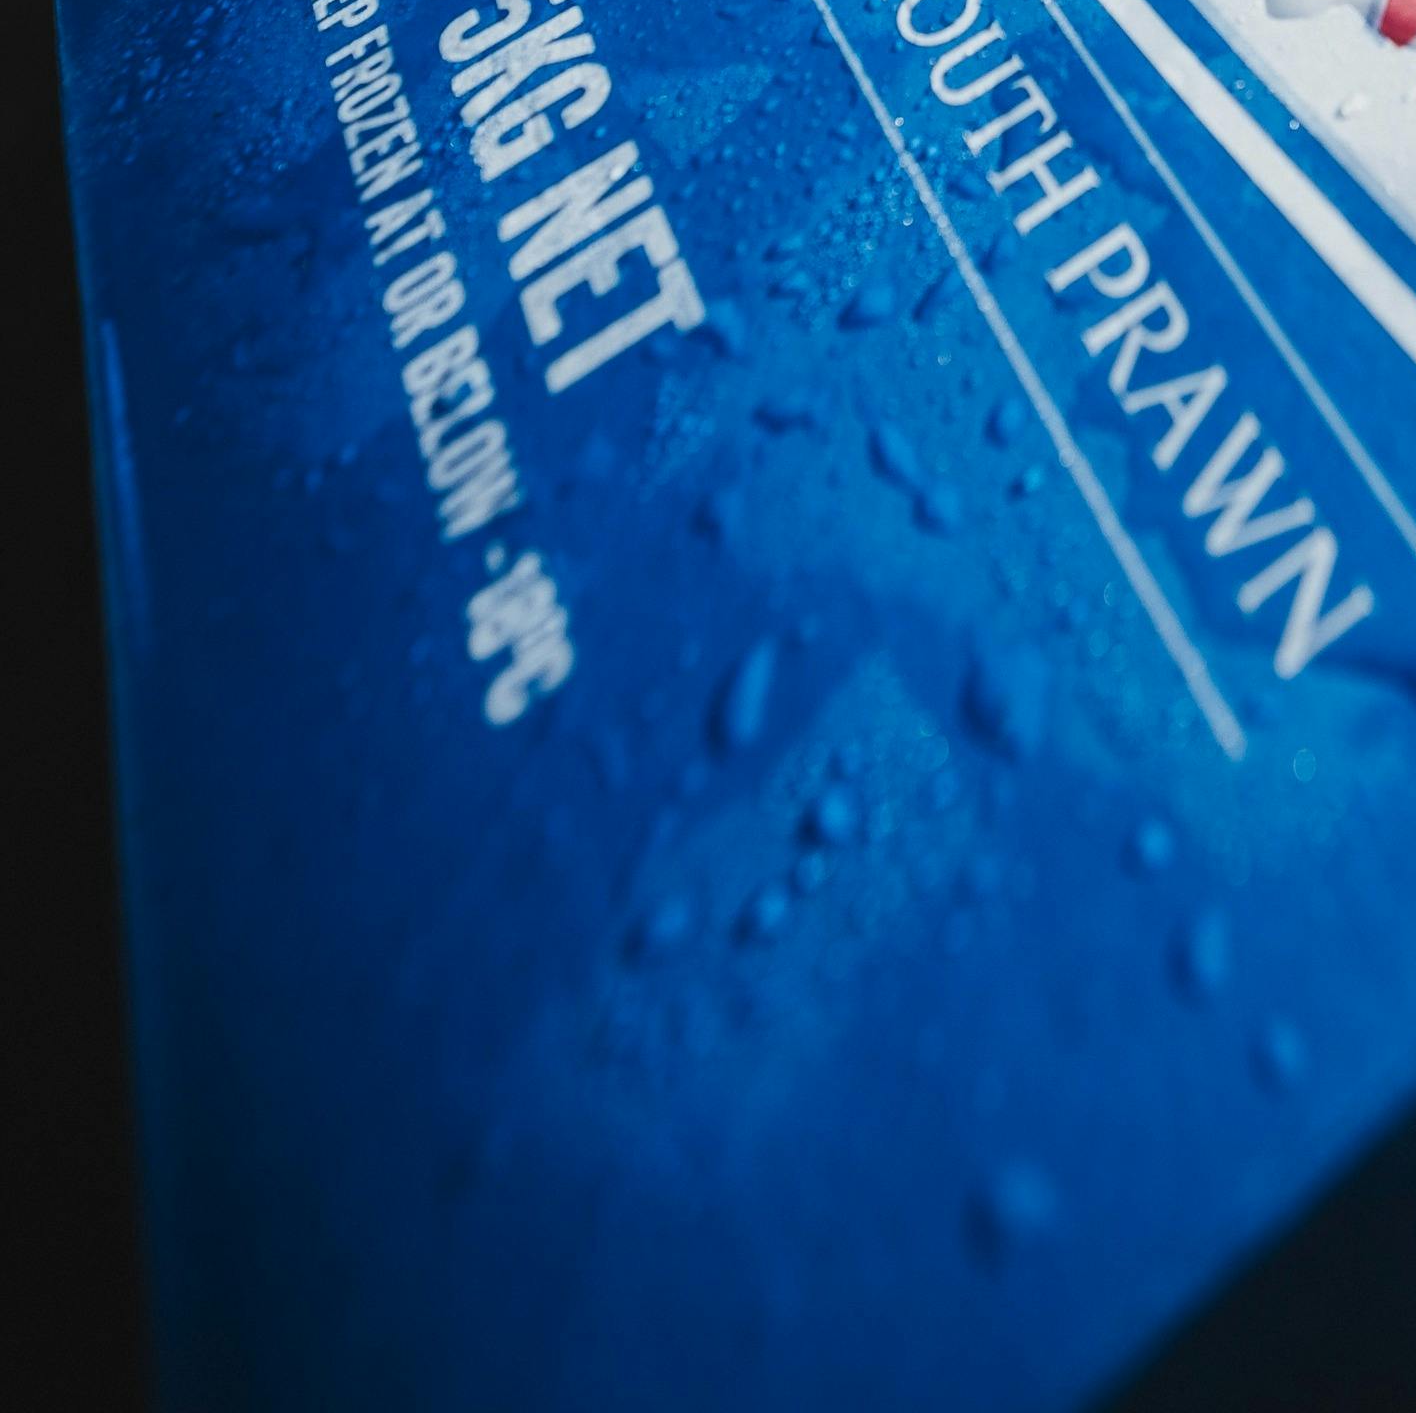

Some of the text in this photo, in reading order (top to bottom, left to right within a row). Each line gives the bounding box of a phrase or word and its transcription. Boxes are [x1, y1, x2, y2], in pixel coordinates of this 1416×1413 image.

[323, 23, 426, 203] FROZEN
[365, 187, 449, 267] AT
[382, 250, 468, 350] OR
[498, 139, 708, 395] NET
[402, 323, 522, 545] BELOW
[1045, 223, 1375, 681] PRAWN
